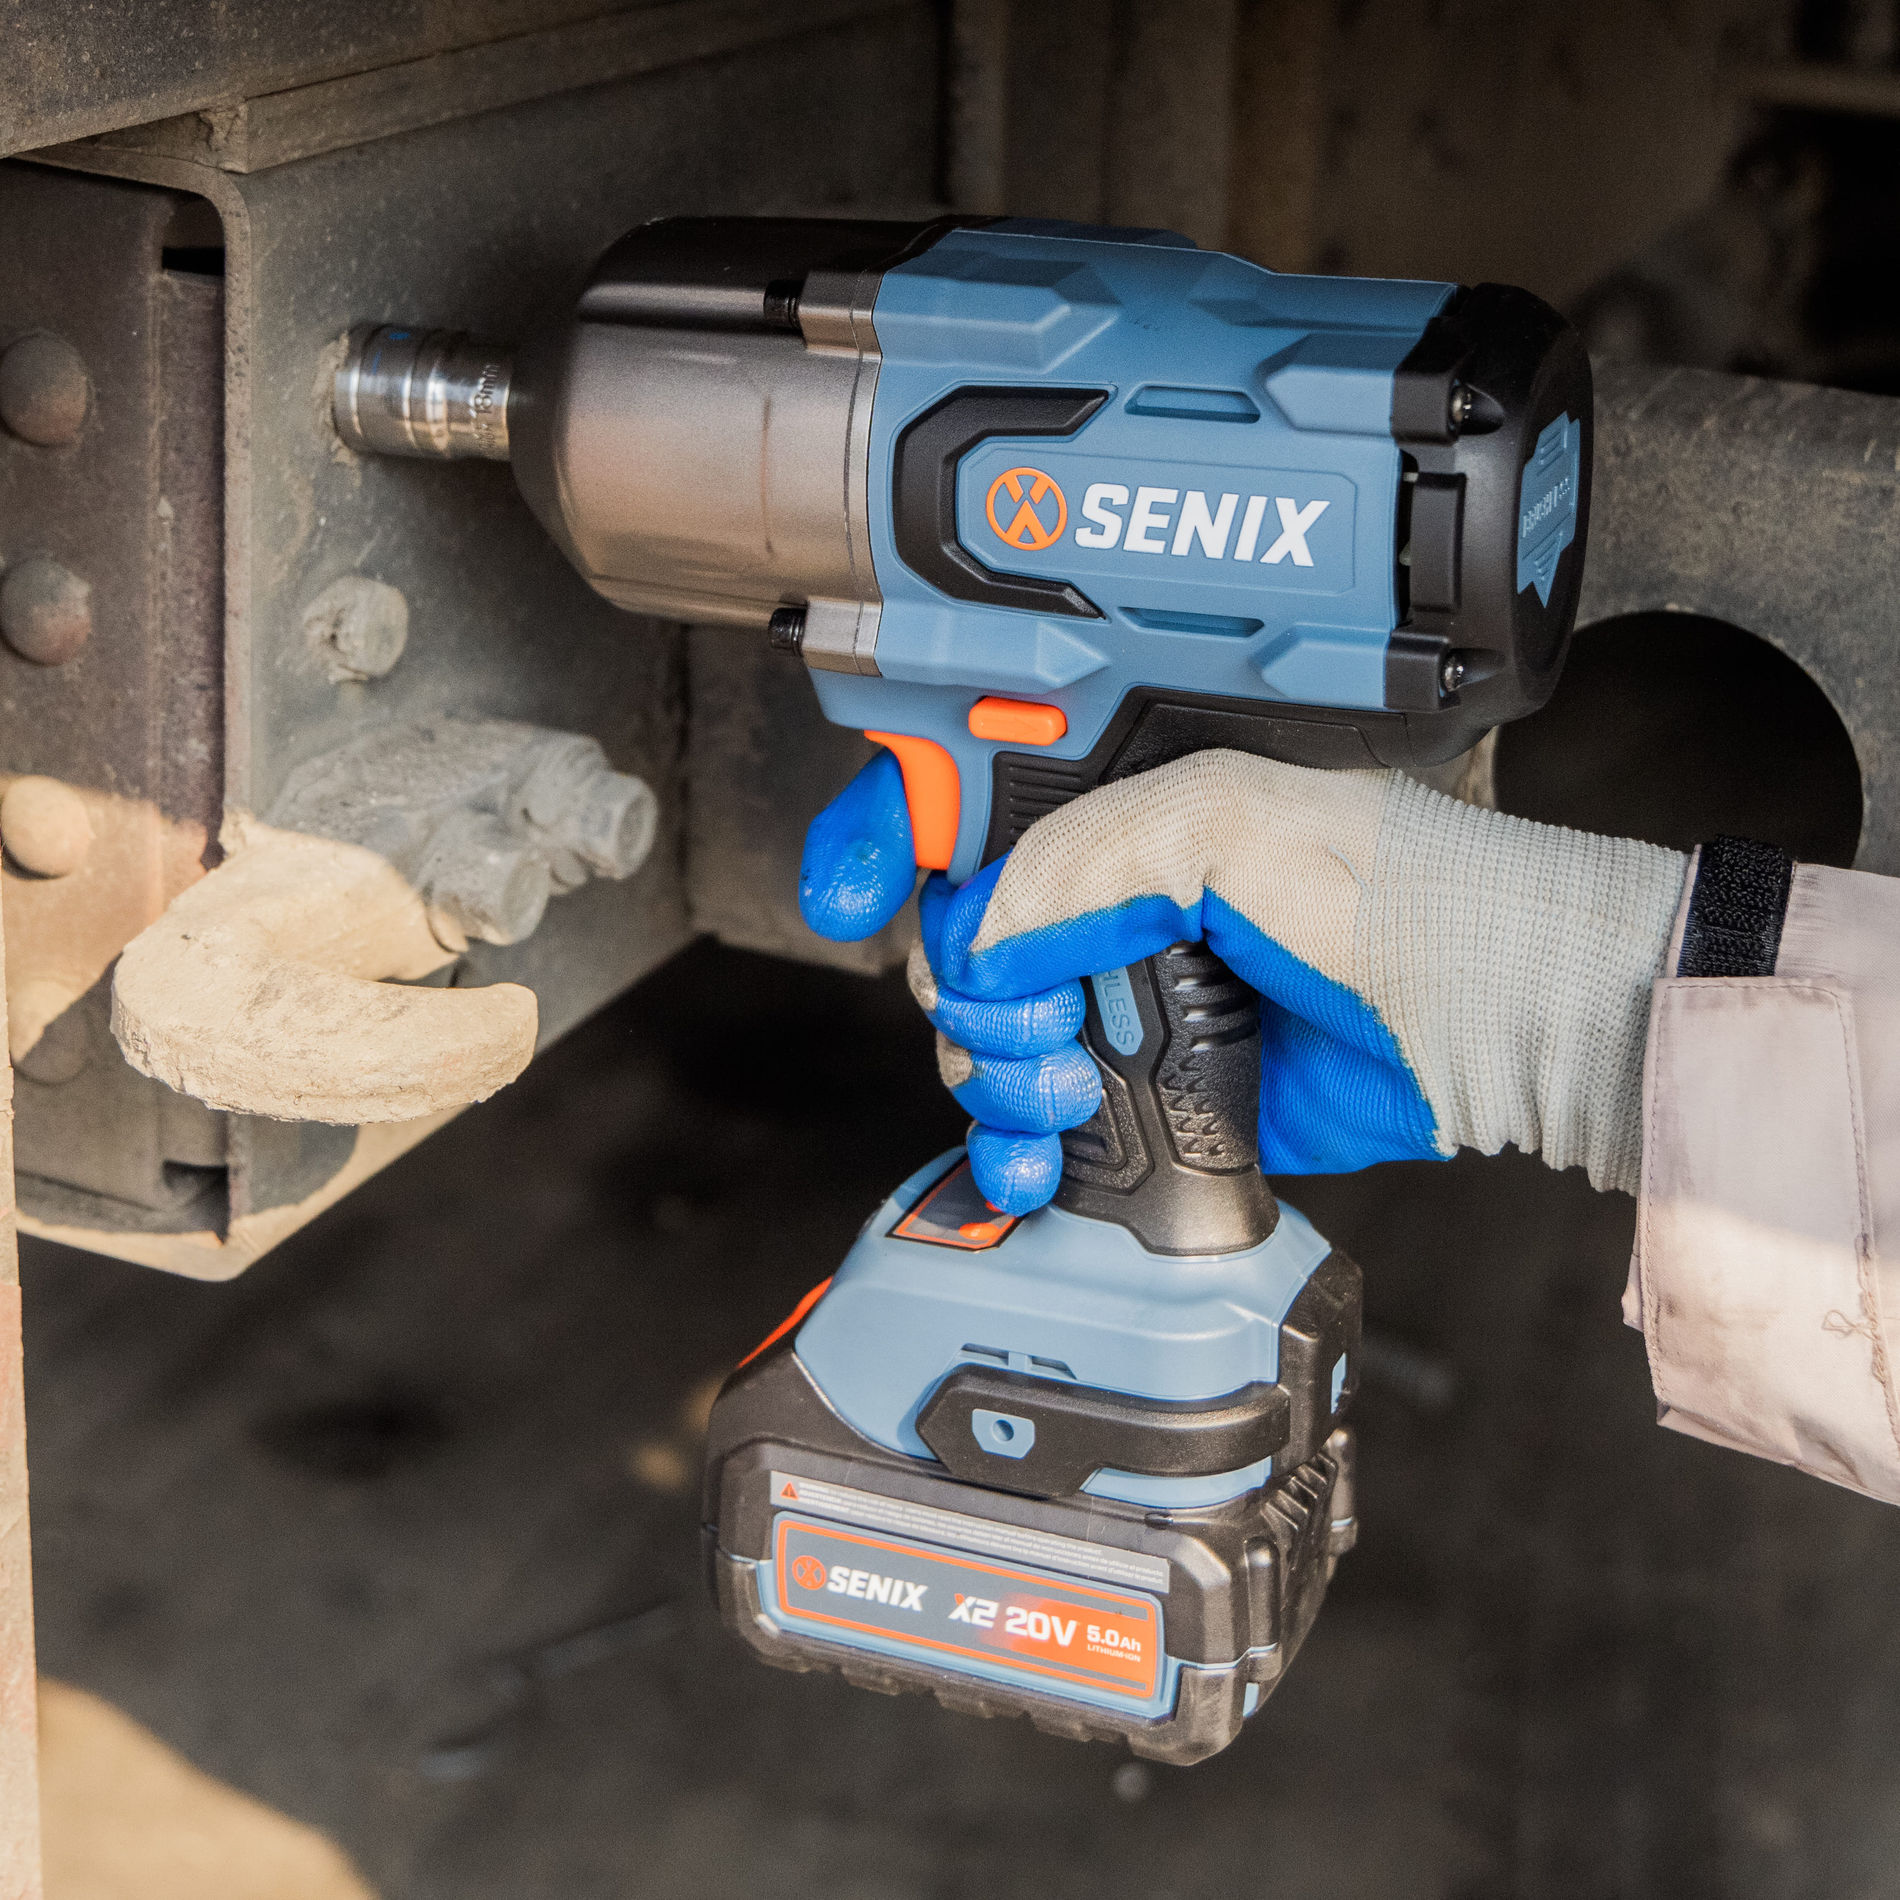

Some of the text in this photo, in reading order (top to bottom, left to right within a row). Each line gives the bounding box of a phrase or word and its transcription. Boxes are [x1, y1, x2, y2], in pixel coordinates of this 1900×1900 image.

[1074, 482, 1331, 567] SENIX
[827, 1565, 929, 1612] SENIX
[948, 1593, 1078, 1647] X2 20V
